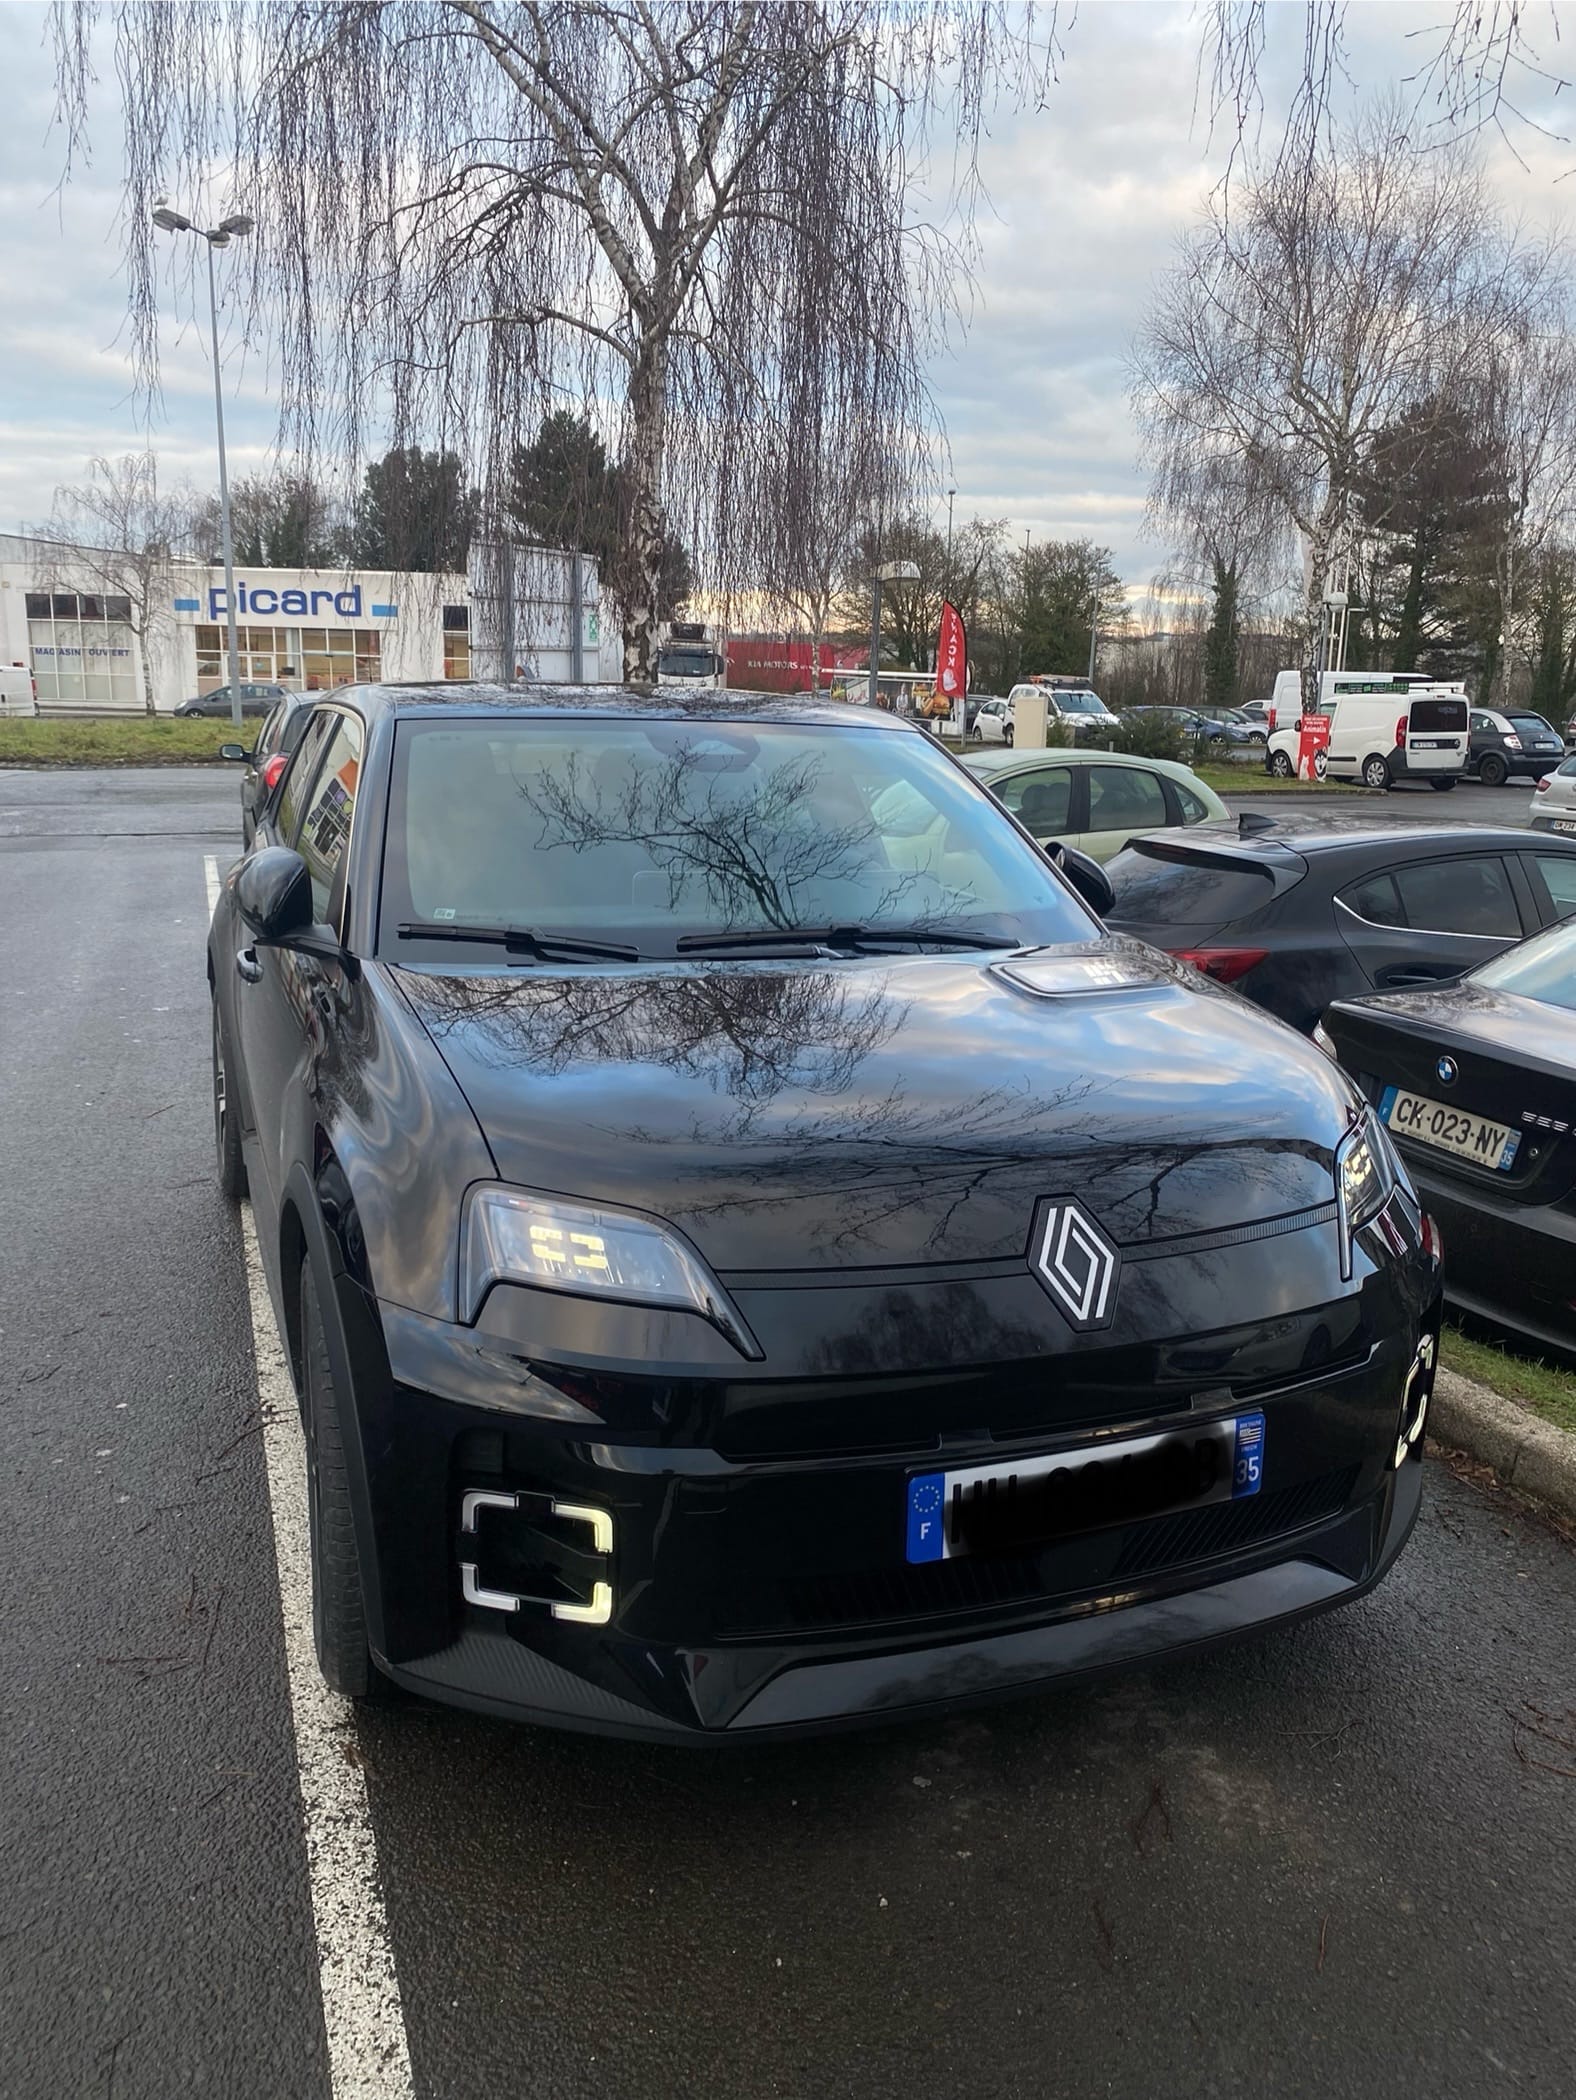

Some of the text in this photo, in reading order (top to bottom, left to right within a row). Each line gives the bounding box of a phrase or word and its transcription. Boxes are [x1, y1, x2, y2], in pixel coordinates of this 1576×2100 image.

[209, 582, 362, 620] picard
[35, 647, 129, 656] MAGASIN OUVERT
[1382, 1107, 1389, 1116] F
[1396, 1097, 1505, 1157] CK-023-NY
[1501, 1149, 1515, 1165] 35
[920, 1455, 1260, 1540] F 35
